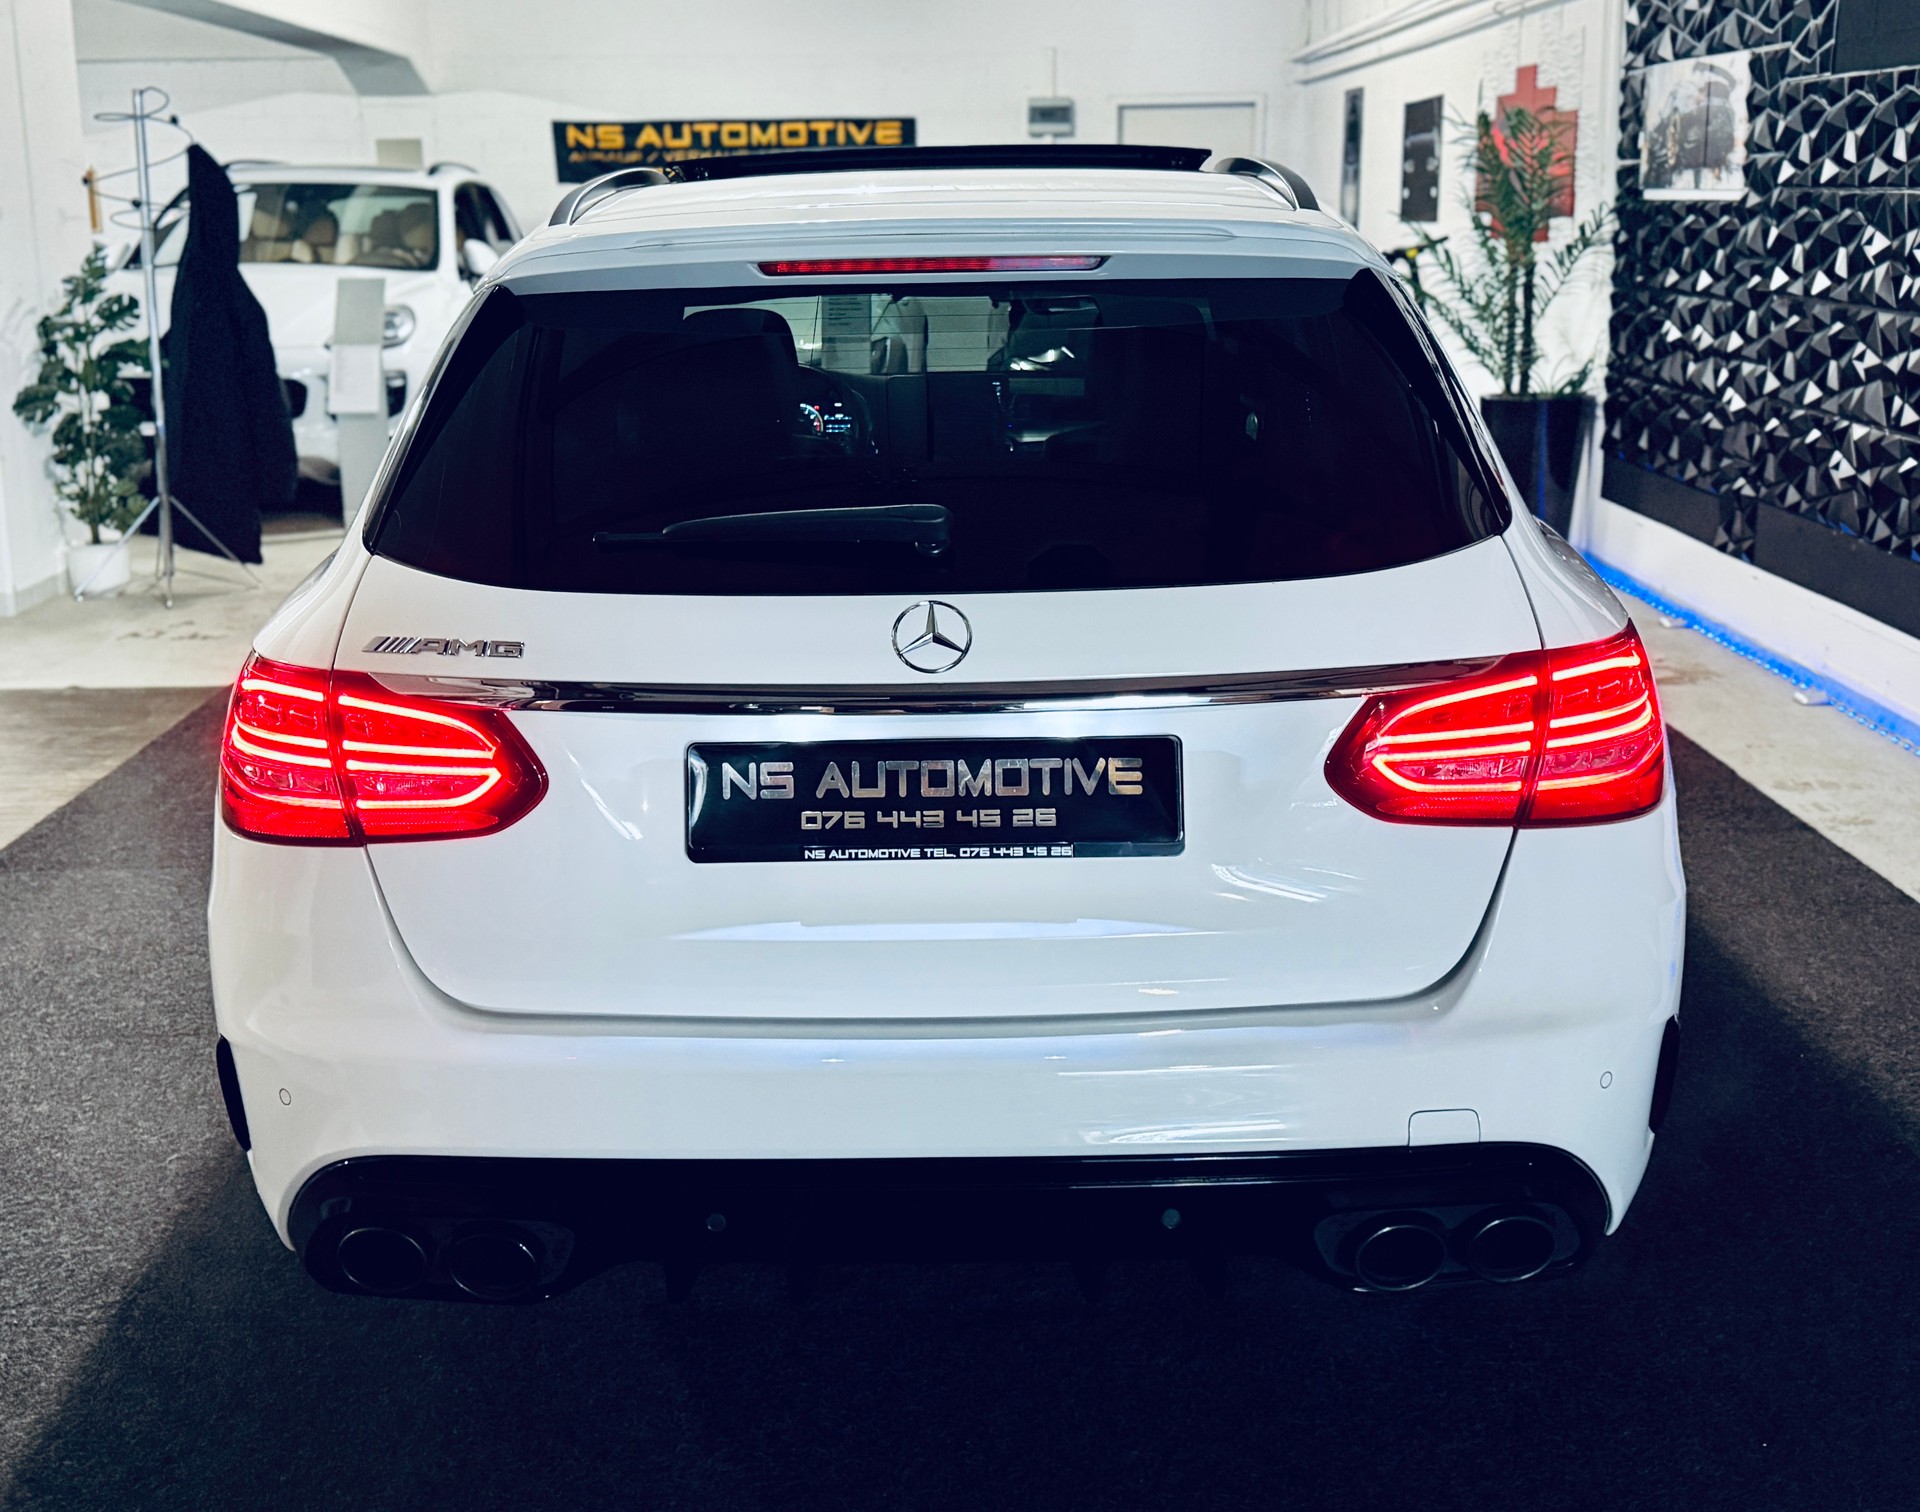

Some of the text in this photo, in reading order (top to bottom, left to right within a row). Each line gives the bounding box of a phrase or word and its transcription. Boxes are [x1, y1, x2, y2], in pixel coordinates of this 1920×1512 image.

[566, 121, 902, 149] NS AUTOMOTIVE
[411, 638, 525, 658] AMG
[722, 758, 1143, 800] NS AUTOMOTIVE
[801, 808, 1056, 830] 076 443 45 26
[805, 846, 1072, 860] NS AUTOMOTIVE TEL. 076 443 45 26
